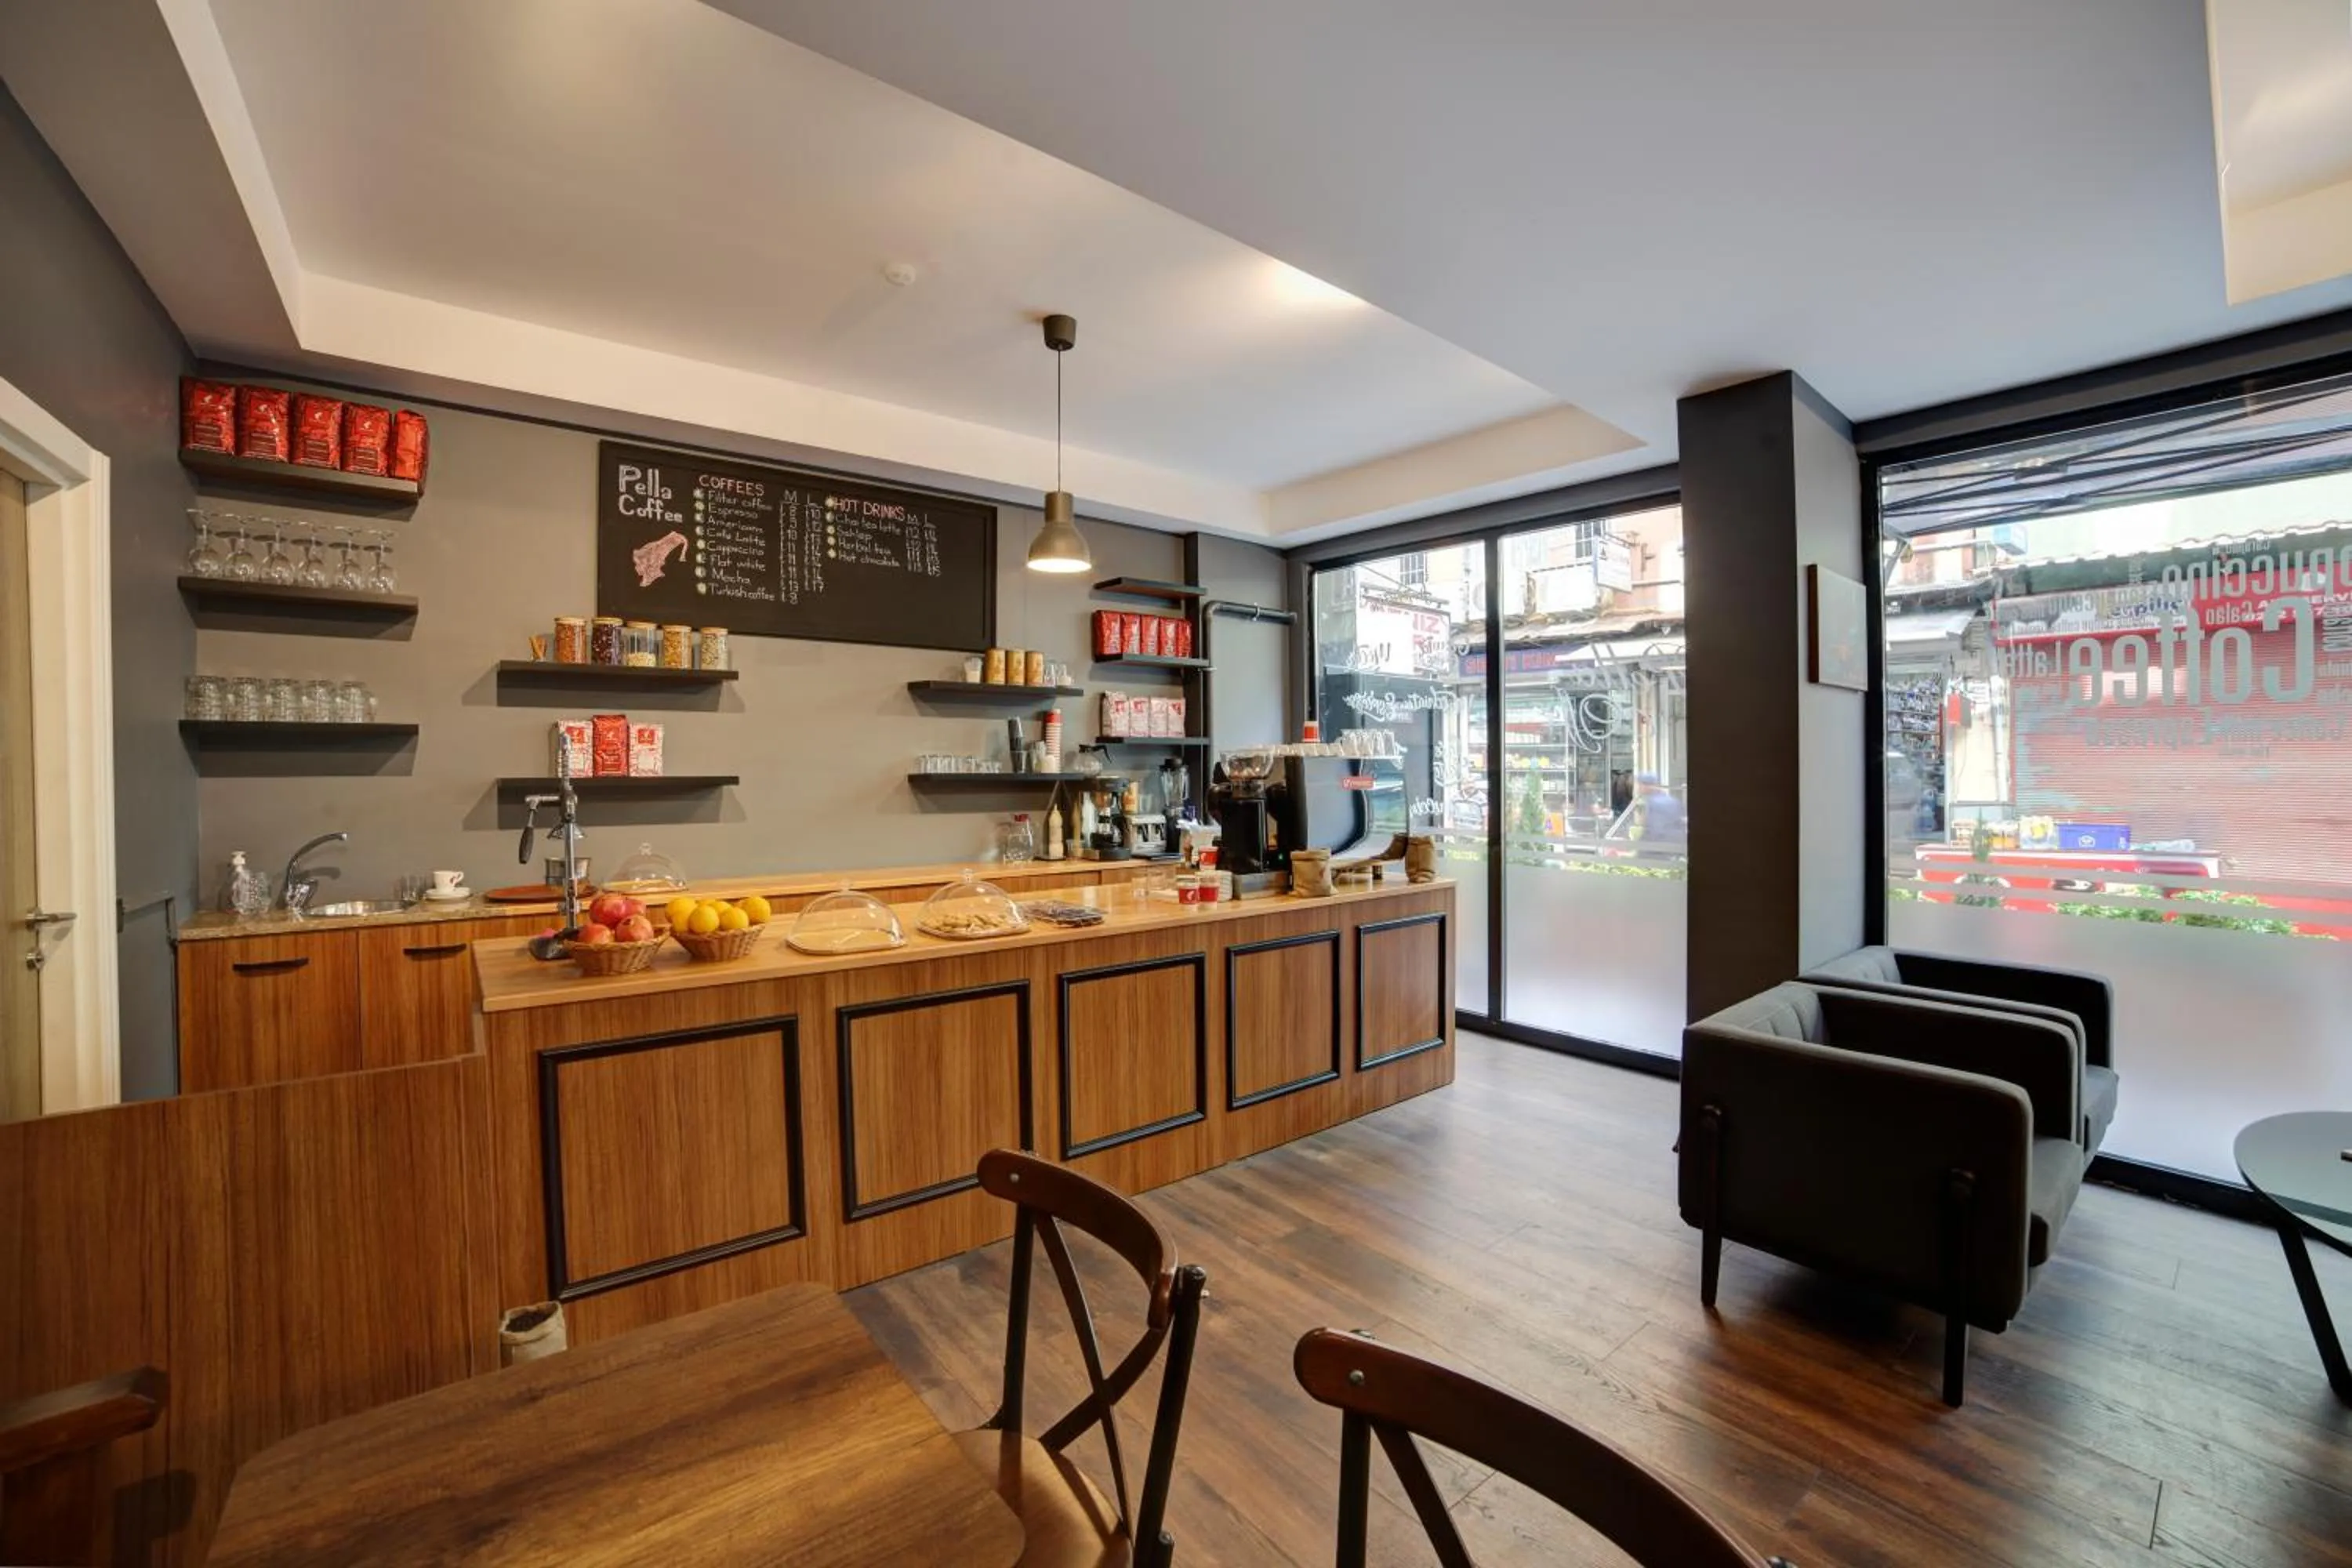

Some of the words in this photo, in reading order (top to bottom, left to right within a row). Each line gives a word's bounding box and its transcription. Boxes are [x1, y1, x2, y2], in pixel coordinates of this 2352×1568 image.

[619, 464, 673, 500] Pella
[699, 474, 765, 496] COFFEES
[784, 489, 797, 503] M
[618, 494, 683, 521] Coffee
[708, 503, 759, 520] Espresso
[833, 497, 858, 514] HOT
[863, 501, 906, 521] DRINKS
[711, 567, 751, 586] Mocha
